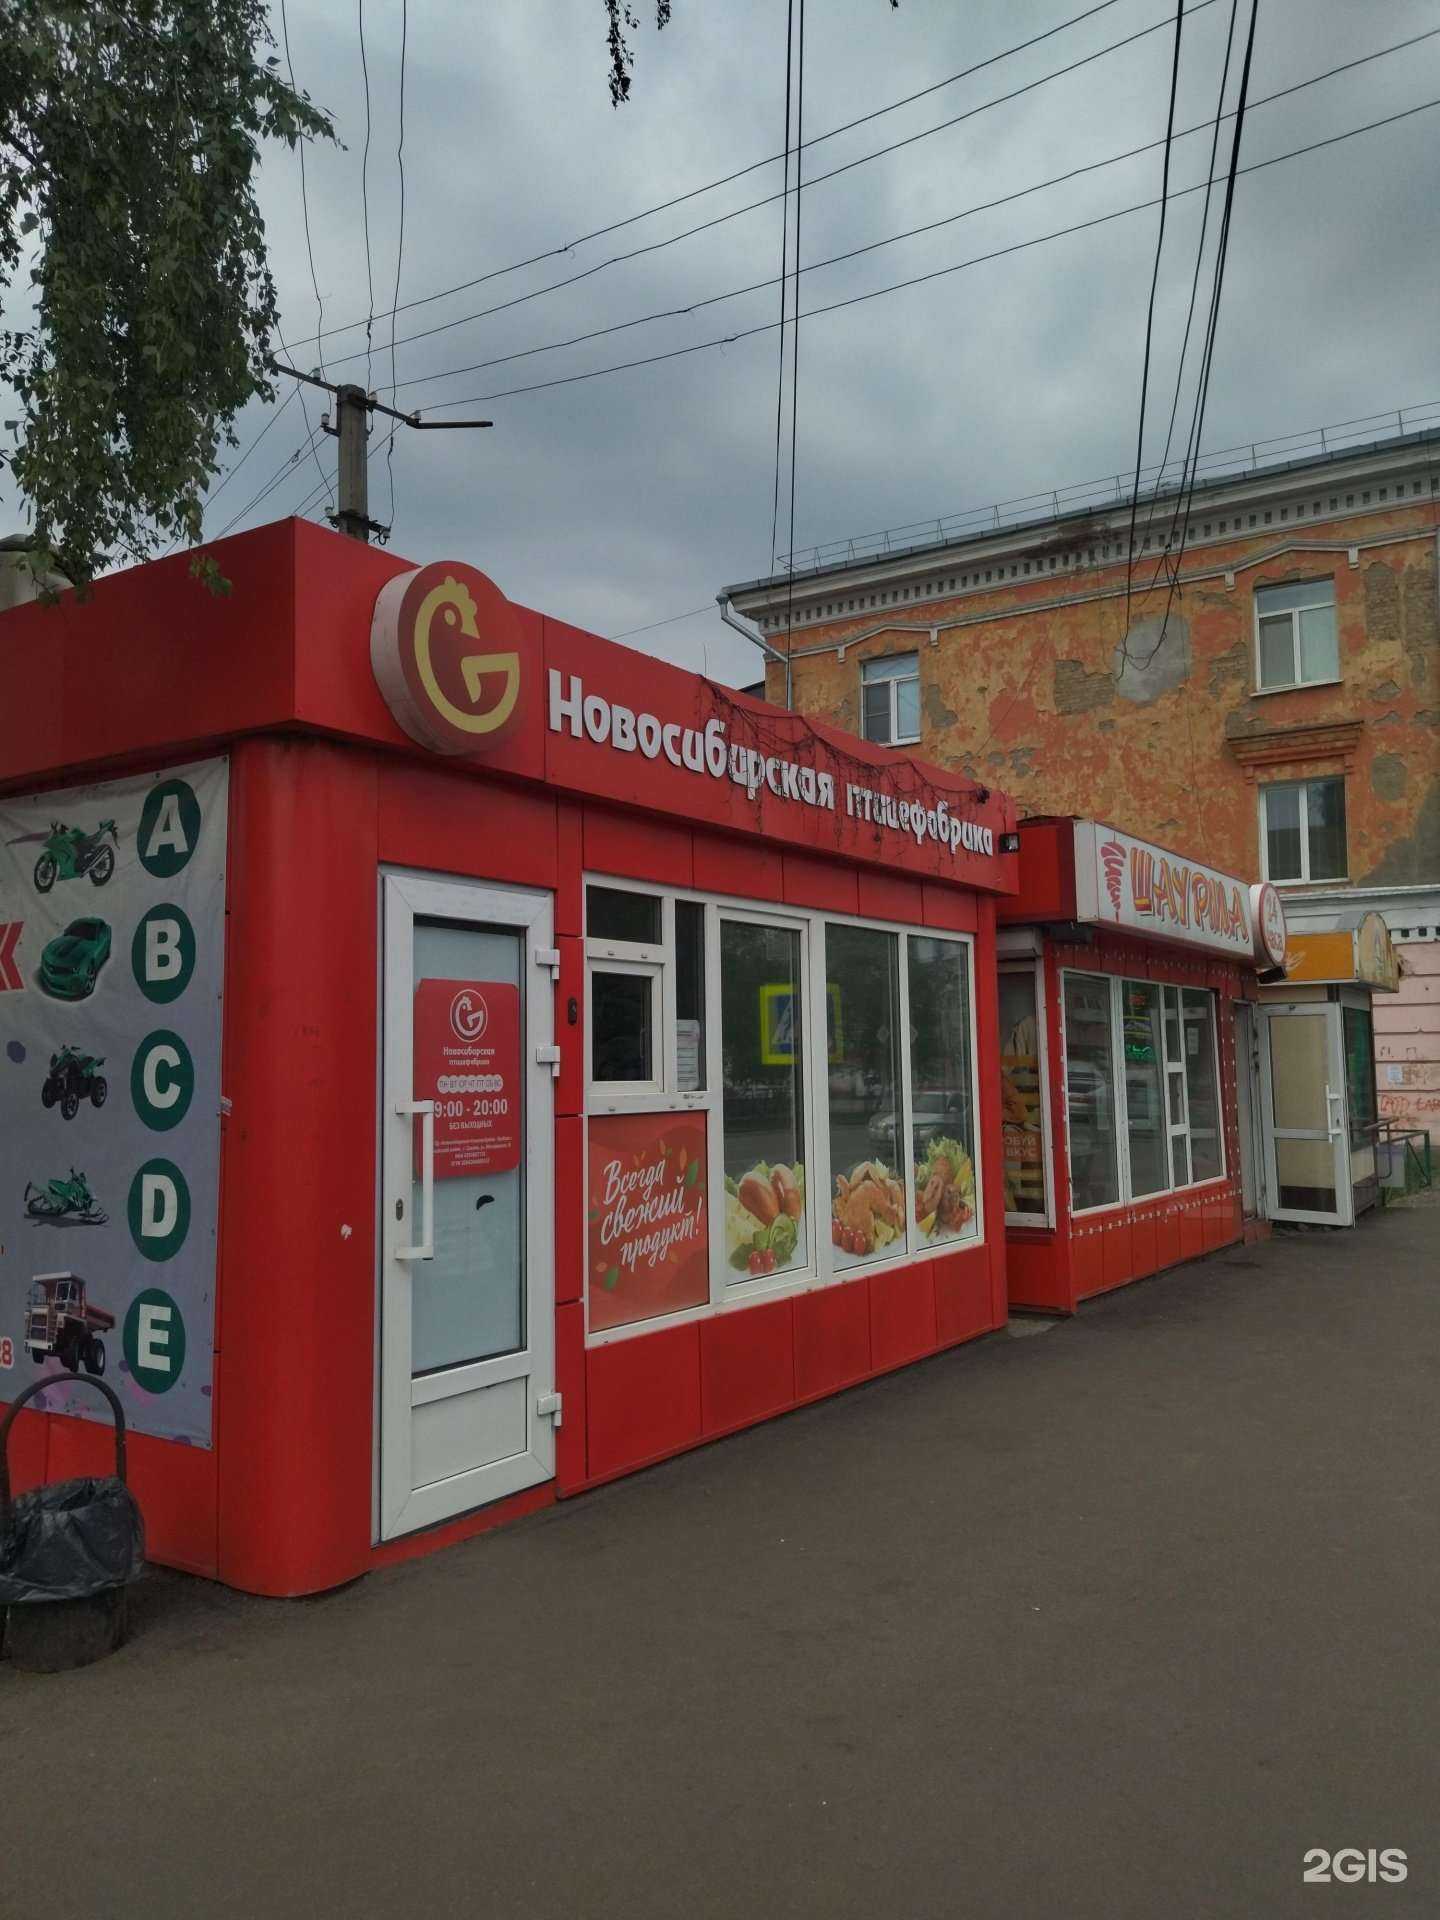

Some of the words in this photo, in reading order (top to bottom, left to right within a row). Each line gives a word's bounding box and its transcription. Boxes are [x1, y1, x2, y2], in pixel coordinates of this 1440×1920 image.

[548, 668, 835, 810] Новосибирская
[846, 783, 994, 856] птицефабрика
[145, 794, 188, 857] A
[1130, 847, 1250, 944] ШАУРМА
[145, 918, 183, 982] B
[143, 1044, 181, 1109] C
[434, 1101, 463, 1118] 9:00
[473, 1099, 508, 1116] 20:00
[141, 1174, 178, 1238] D
[601, 1175, 685, 1245] свежий
[603, 1160, 666, 1206] Всегда
[620, 1196, 703, 1273] продукт!
[138, 1304, 172, 1372] E
